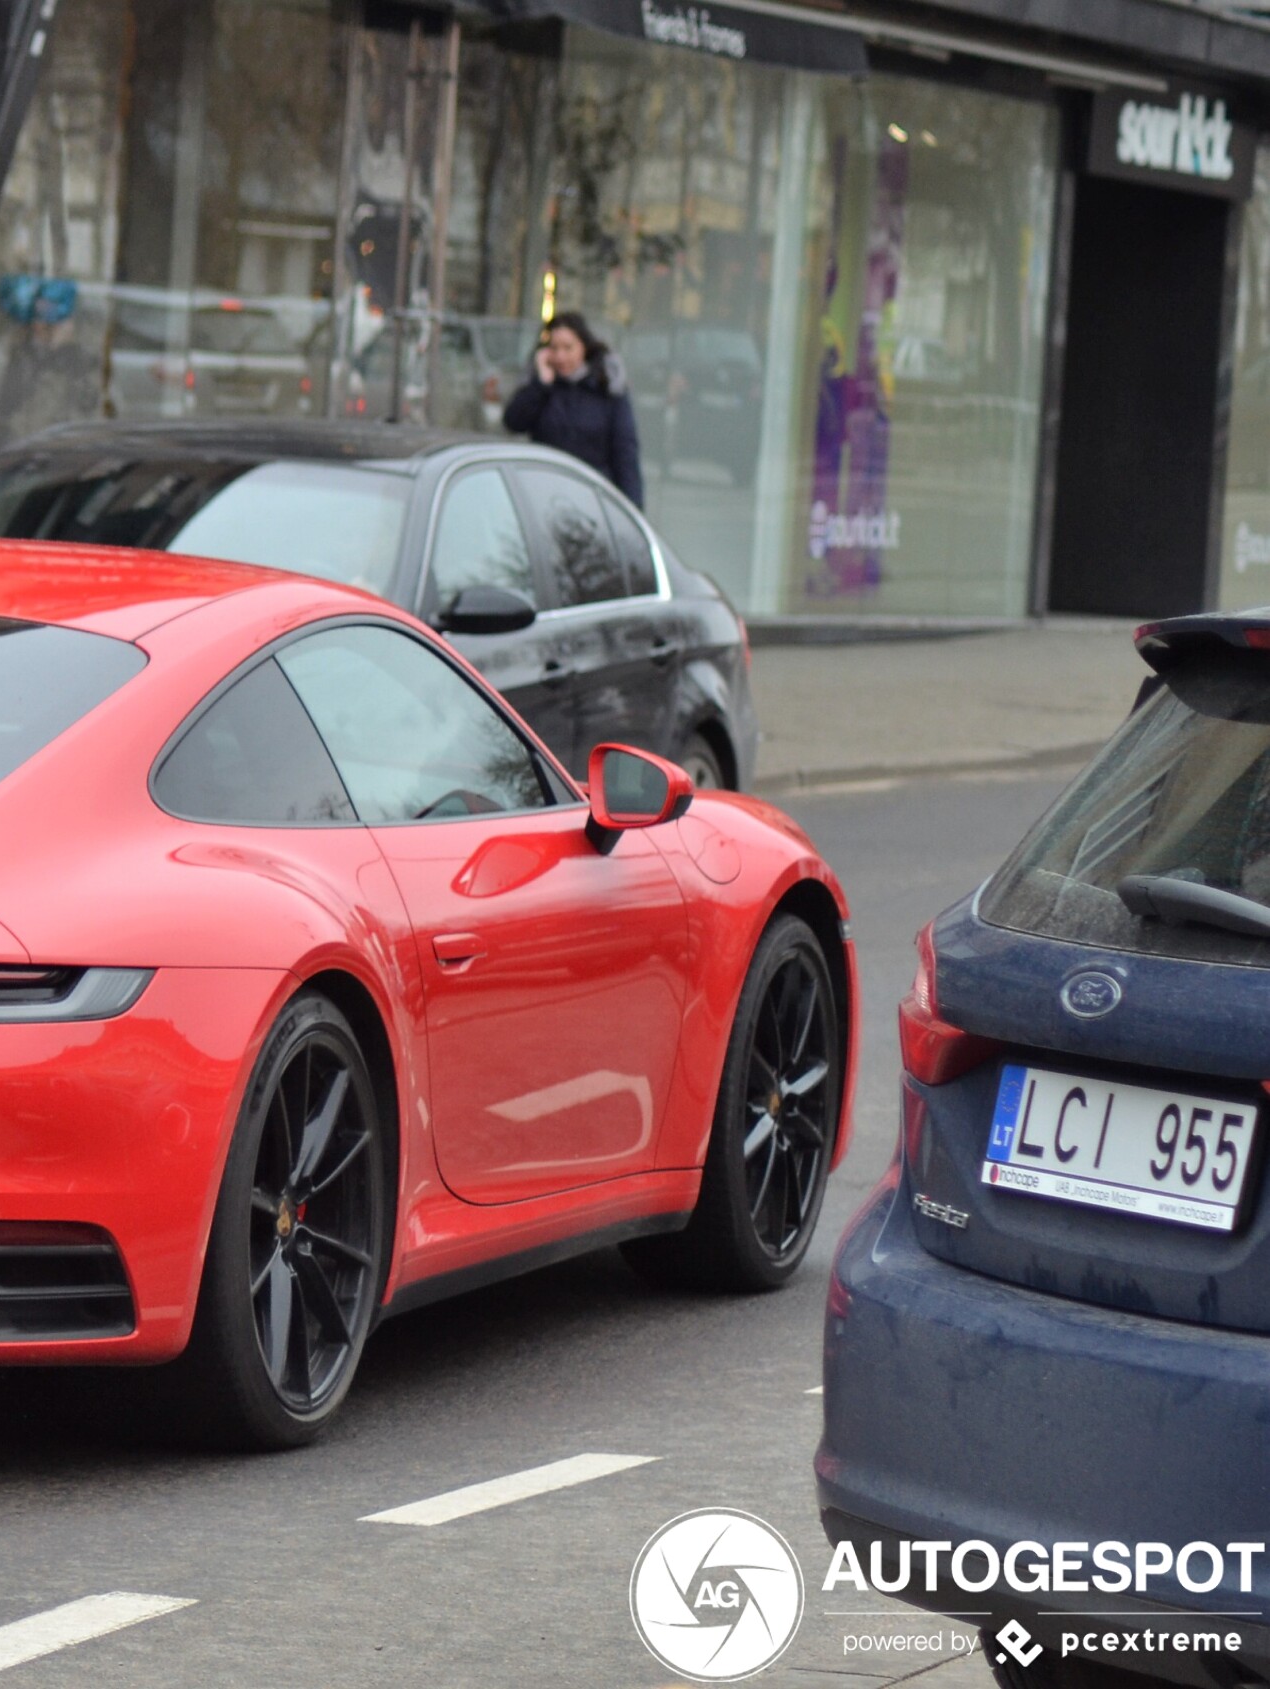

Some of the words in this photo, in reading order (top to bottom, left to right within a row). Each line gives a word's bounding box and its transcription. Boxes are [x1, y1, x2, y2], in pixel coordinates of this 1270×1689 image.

[992, 1124, 1013, 1148] LT
[1017, 1079, 1115, 1169] LCI
[1150, 1103, 1245, 1193] 955
[913, 1193, 970, 1230] Fiesta
